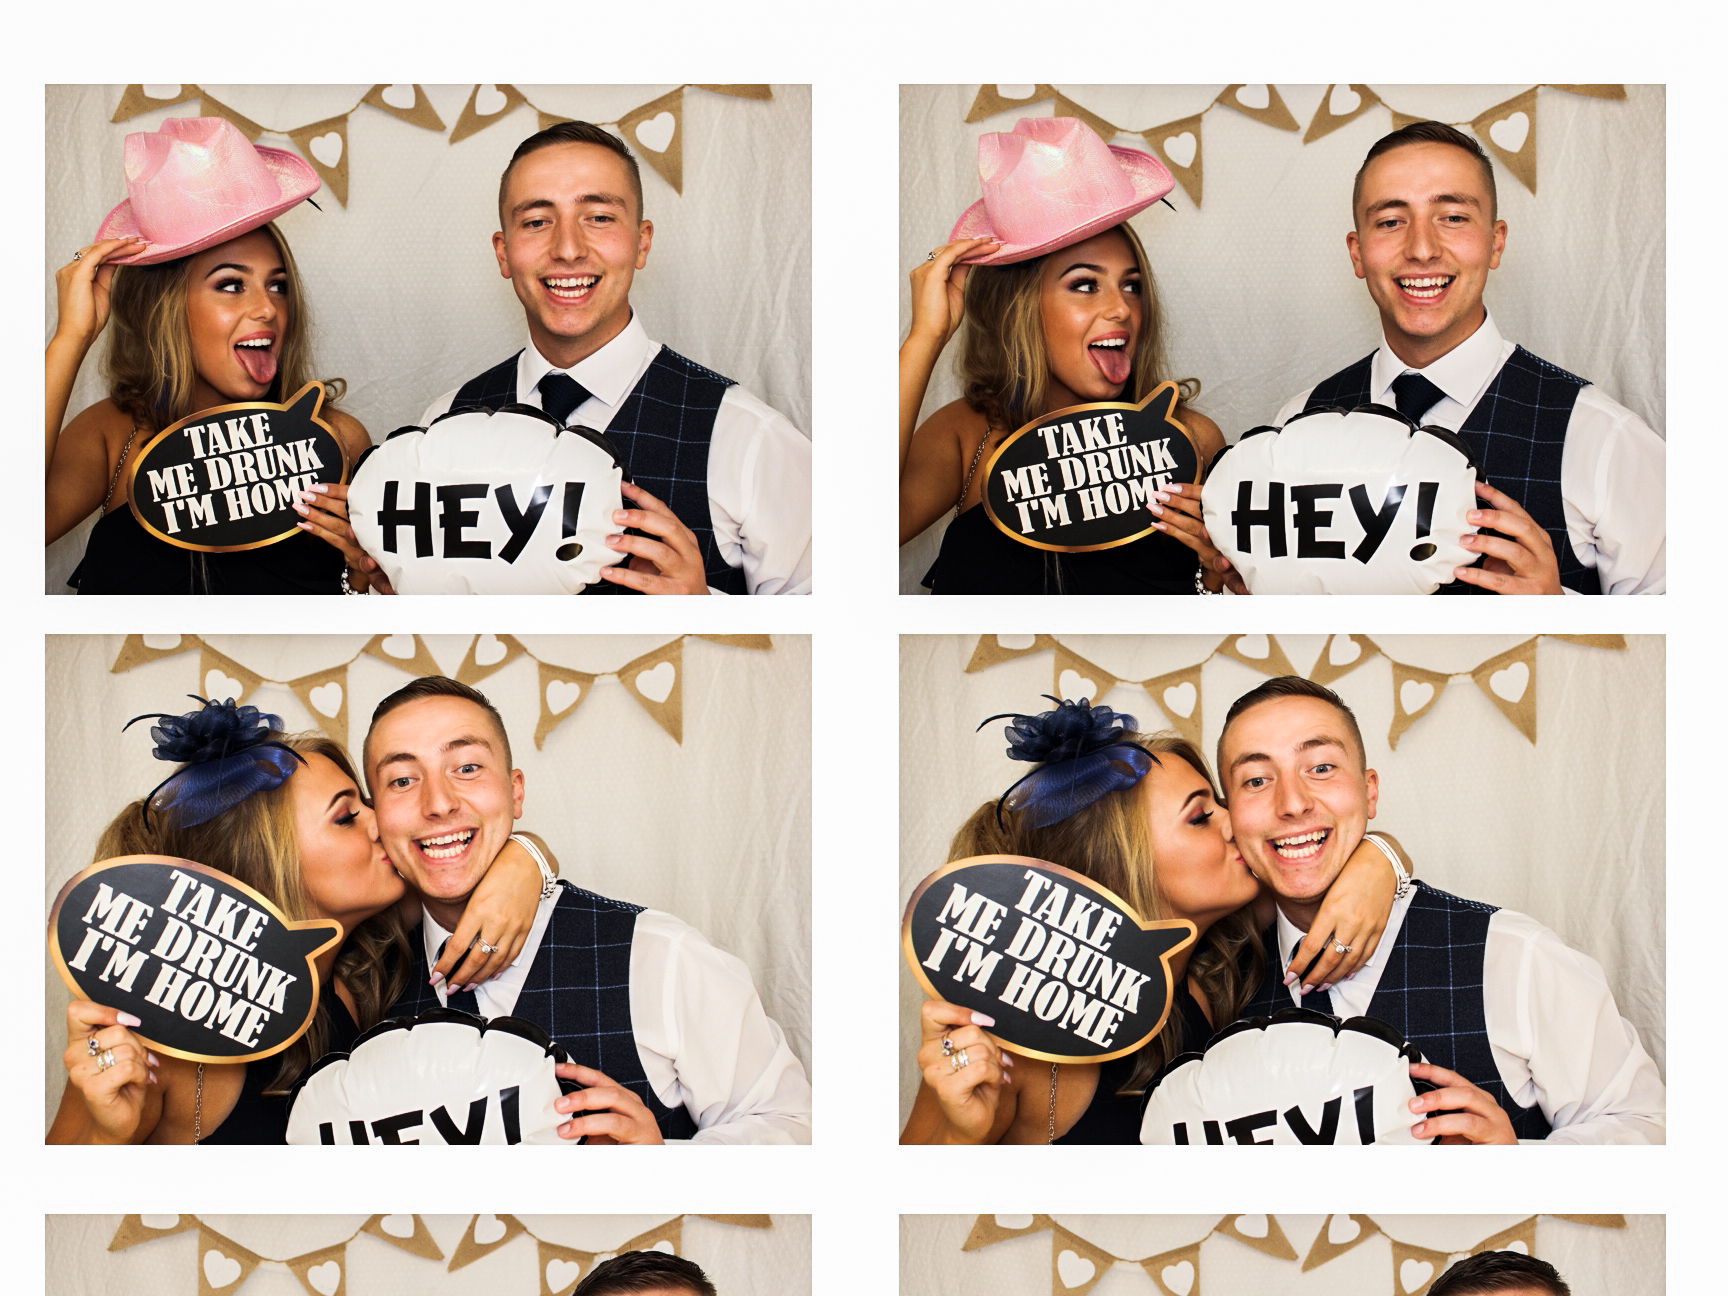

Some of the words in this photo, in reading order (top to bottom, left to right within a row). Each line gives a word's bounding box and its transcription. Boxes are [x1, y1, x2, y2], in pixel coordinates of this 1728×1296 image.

[147, 463, 198, 502] ME
[204, 438, 324, 491] DRUNK
[183, 412, 273, 459] TAKE
[1001, 463, 1052, 502] ME
[1058, 438, 1178, 491] DRUNK
[1037, 412, 1127, 459] TAKE
[161, 494, 218, 534] I'M
[377, 480, 586, 564] HEY!
[1015, 494, 1072, 534] I'M
[1231, 480, 1440, 564] HEY!
[81, 882, 155, 946] ME
[149, 917, 297, 1015] DRUNK
[159, 869, 269, 952] TAKE
[935, 882, 1009, 946] ME
[1003, 917, 1151, 1015] DRUNK
[1013, 869, 1123, 952] TAKE
[68, 930, 150, 993] I'M
[144, 961, 272, 1049] HOME
[922, 930, 1004, 993] I'M
[998, 961, 1126, 1049] HOME
